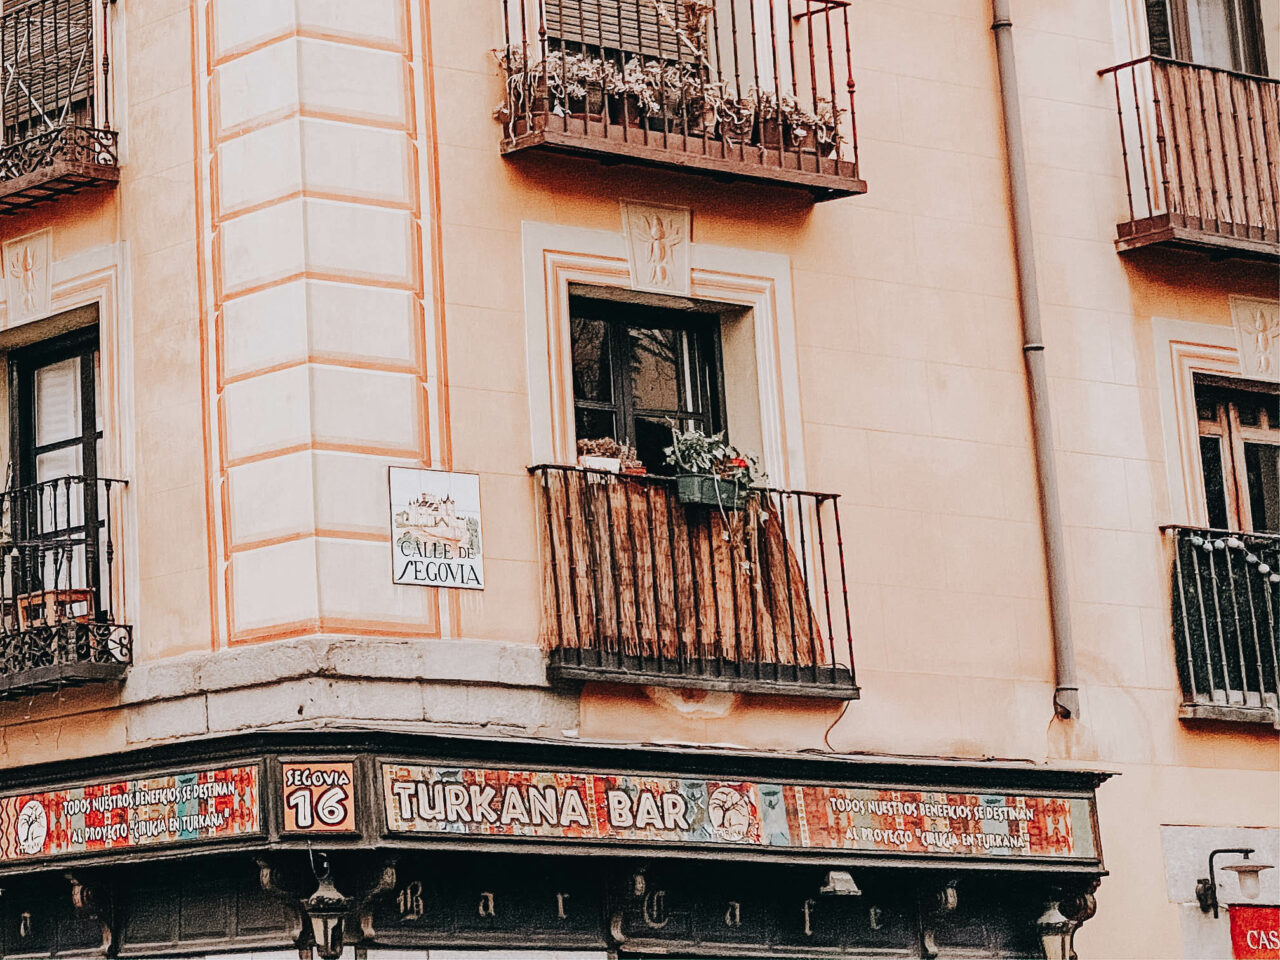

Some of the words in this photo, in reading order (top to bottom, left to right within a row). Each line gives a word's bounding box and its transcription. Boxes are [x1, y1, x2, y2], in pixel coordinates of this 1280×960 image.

[400, 540, 454, 560] CALLE
[458, 546, 477, 560] DE
[396, 560, 482, 586] SEGOVIA
[285, 769, 350, 787] SEGOVIA
[62, 799, 91, 816] TODOS
[93, 794, 134, 812] NUESTROS
[135, 789, 181, 807] BENEFICIOS
[183, 787, 194, 800] SE
[193, 781, 235, 799] DESTINAN
[287, 789, 347, 828] 16
[392, 781, 591, 828] TURKANA
[608, 790, 690, 831] BAR
[830, 797, 865, 813] TODOS
[867, 799, 918, 817] NUESTROS
[919, 803, 972, 821] BENEFICIOS
[974, 806, 985, 820] SE
[986, 806, 1034, 822] DESTINAN
[72, 830, 84, 843] AL
[85, 822, 127, 842] PROYECTO
[169, 817, 180, 831] EN
[845, 828, 858, 841] AL
[860, 828, 913, 845] PROYECTO
[961, 833, 974, 846] EN
